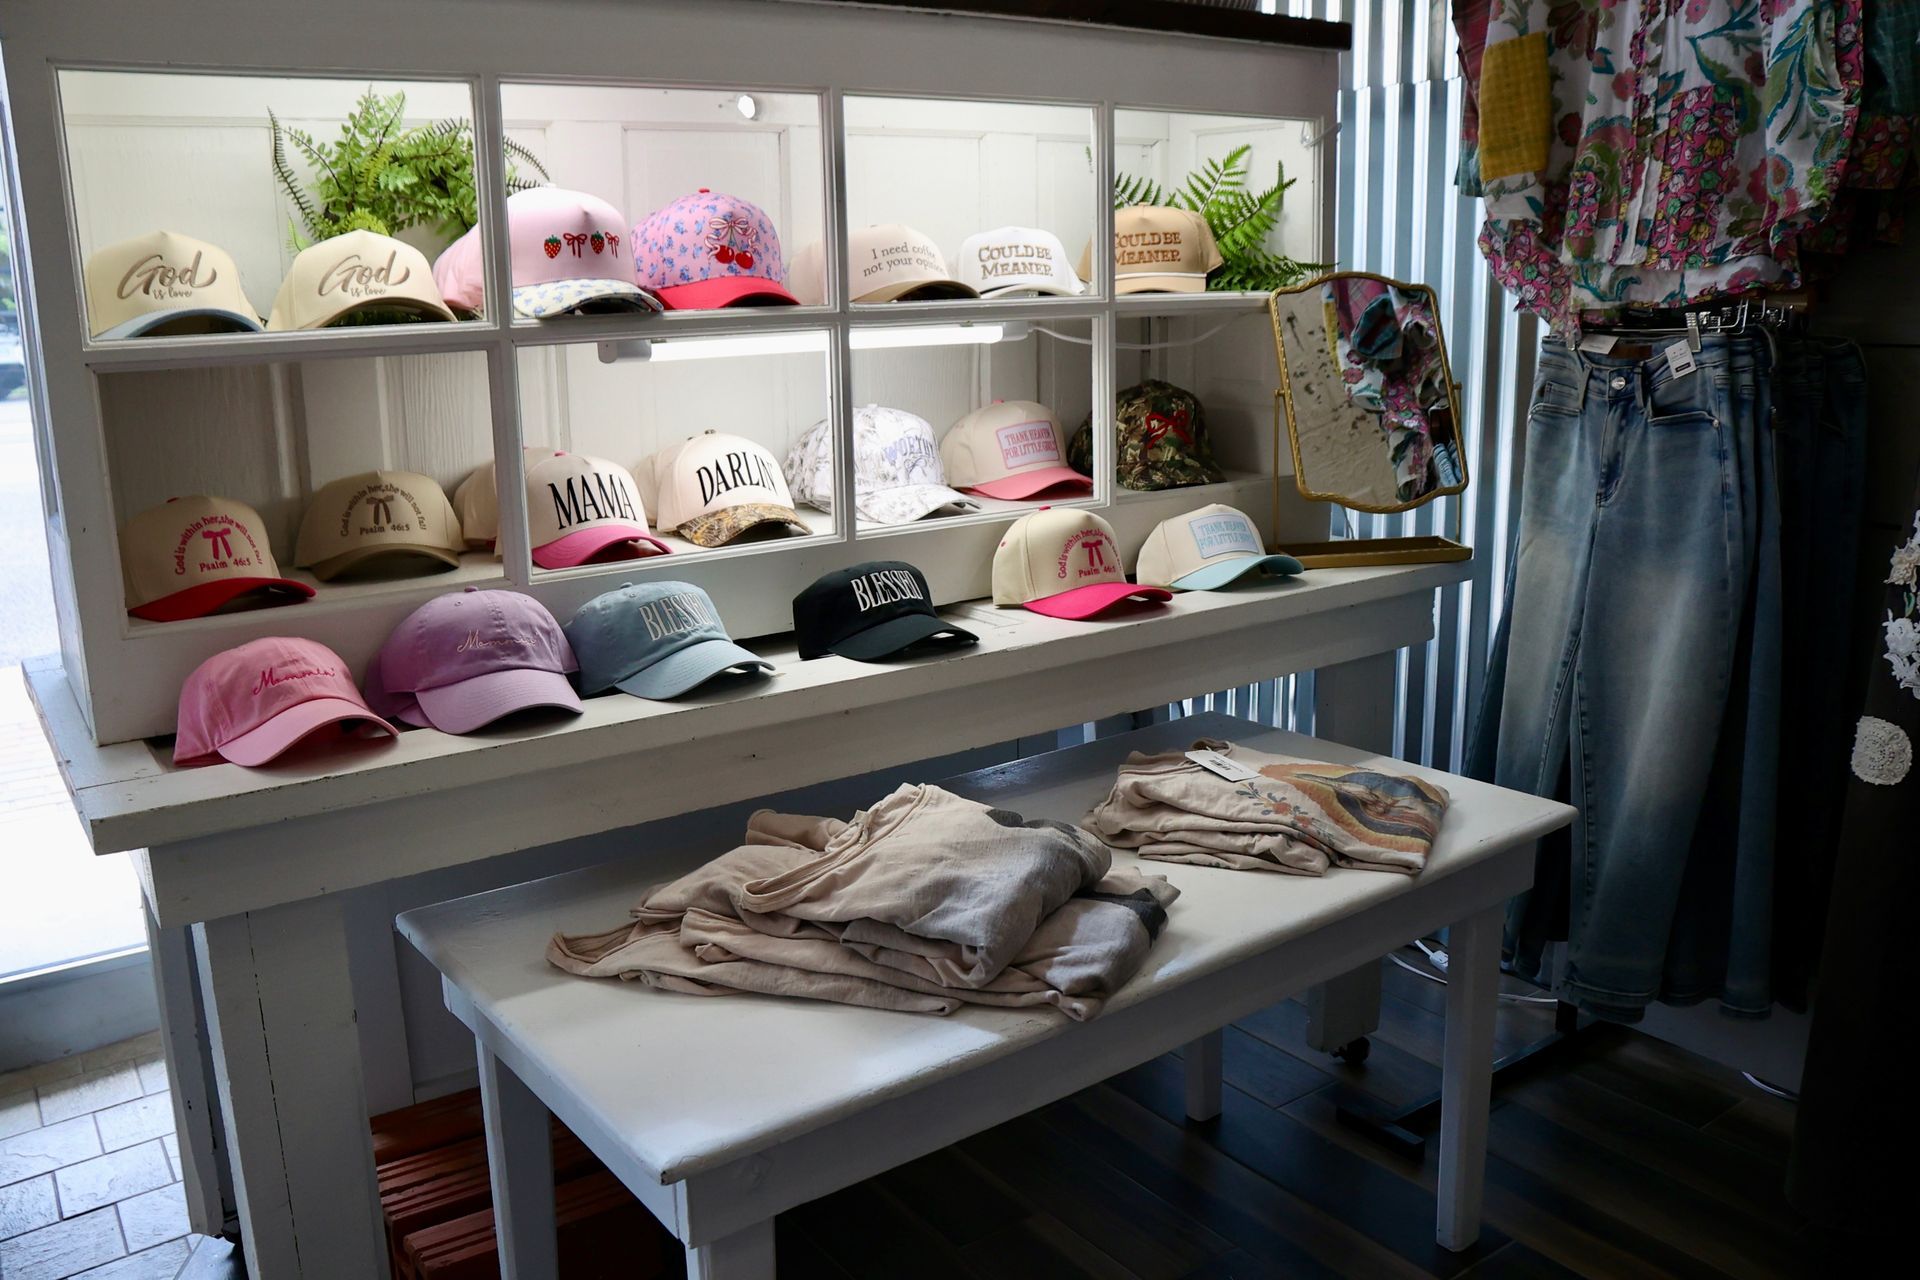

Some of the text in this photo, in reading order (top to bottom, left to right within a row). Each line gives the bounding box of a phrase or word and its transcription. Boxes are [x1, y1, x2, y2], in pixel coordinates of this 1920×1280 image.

[1162, 231, 1182, 245] BE
[872, 248, 878, 259] I
[881, 242, 909, 257] need
[978, 244, 1034, 262] COULD
[117, 250, 217, 299] God
[318, 250, 410, 296] God
[863, 262, 884, 277] not
[886, 257, 913, 272] your
[152, 286, 193, 300] is love
[350, 284, 387, 298] is love
[547, 472, 638, 530] MAMA
[1058, 561, 1067, 578] God
[1065, 535, 1081, 554] within
[200, 561, 227, 572] Psalm
[1079, 567, 1099, 578] Psalm
[850, 570, 924, 612] BLESSED
